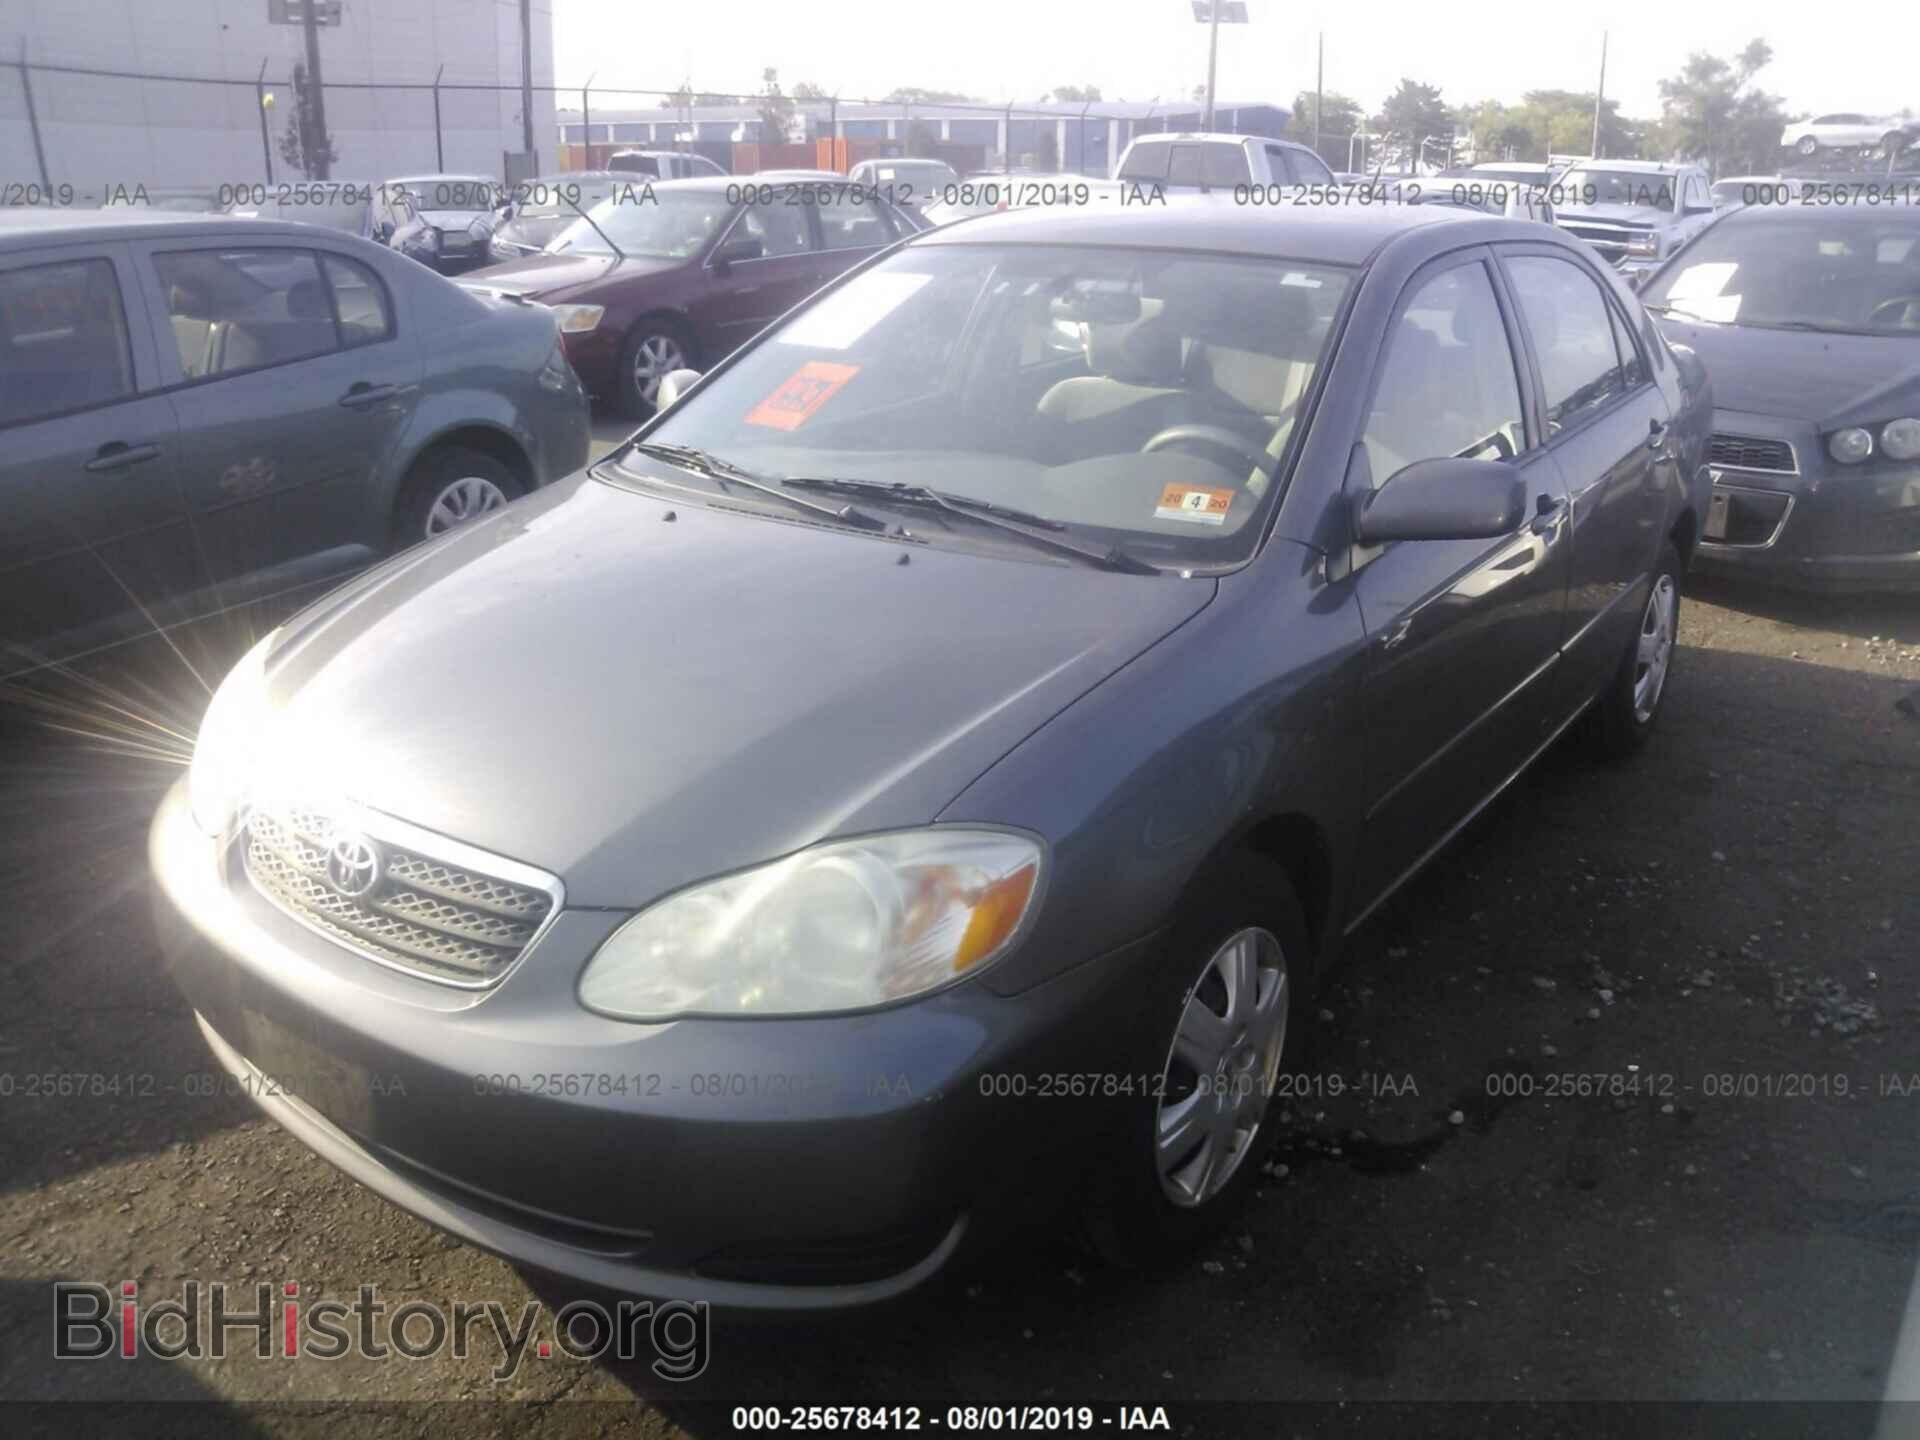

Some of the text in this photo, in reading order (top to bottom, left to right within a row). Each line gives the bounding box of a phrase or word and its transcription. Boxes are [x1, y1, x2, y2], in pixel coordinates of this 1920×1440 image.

[1165, 494, 1227, 508] 20 4 20
